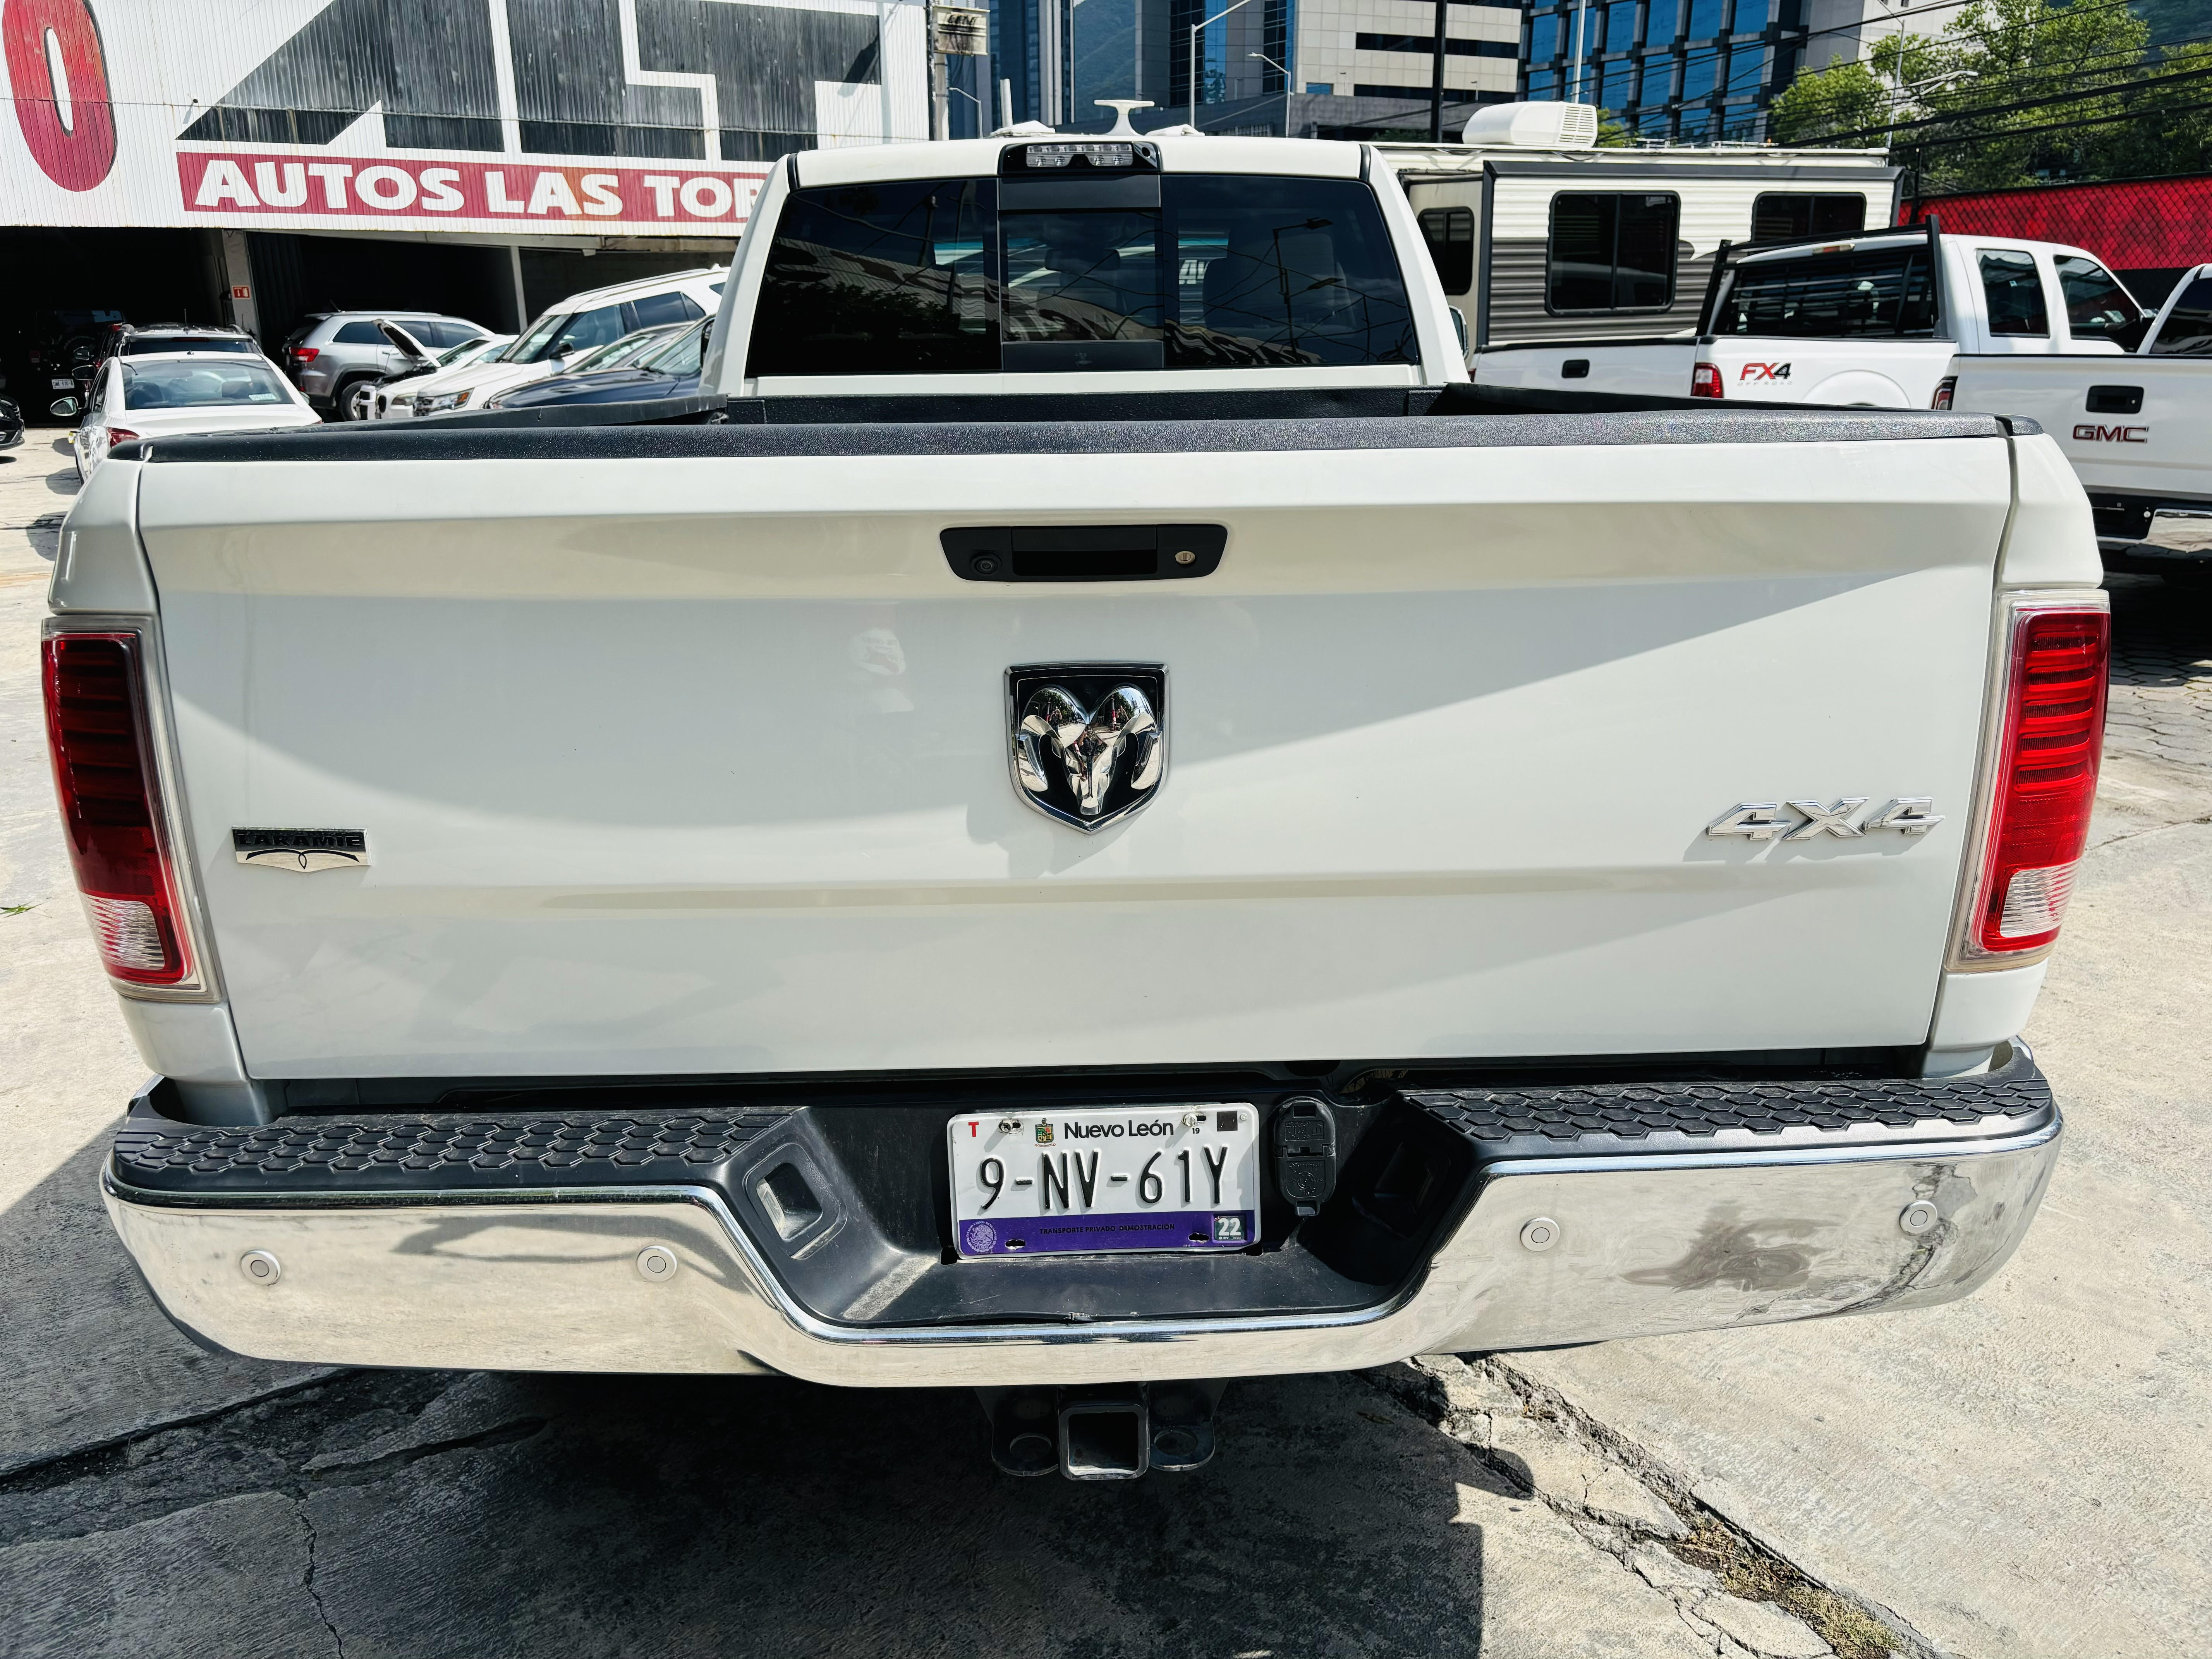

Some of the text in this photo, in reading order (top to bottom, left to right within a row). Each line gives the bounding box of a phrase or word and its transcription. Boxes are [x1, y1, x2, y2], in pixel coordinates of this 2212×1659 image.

[195, 160, 464, 211] AUTOS
[485, 171, 623, 216] LAS
[1740, 362, 1792, 380] FX4
[2073, 424, 2149, 443] GMC
[1706, 796, 1946, 841] 4X4
[237, 834, 361, 847] LARAMIE
[969, 1121, 979, 1137] T
[1064, 1119, 1174, 1139] Nuevo León
[981, 1146, 1228, 1210] 9-NV-61Y
[1039, 1226, 1084, 1235] TRANSPORTE
[1218, 1218, 1241, 1236] 22
